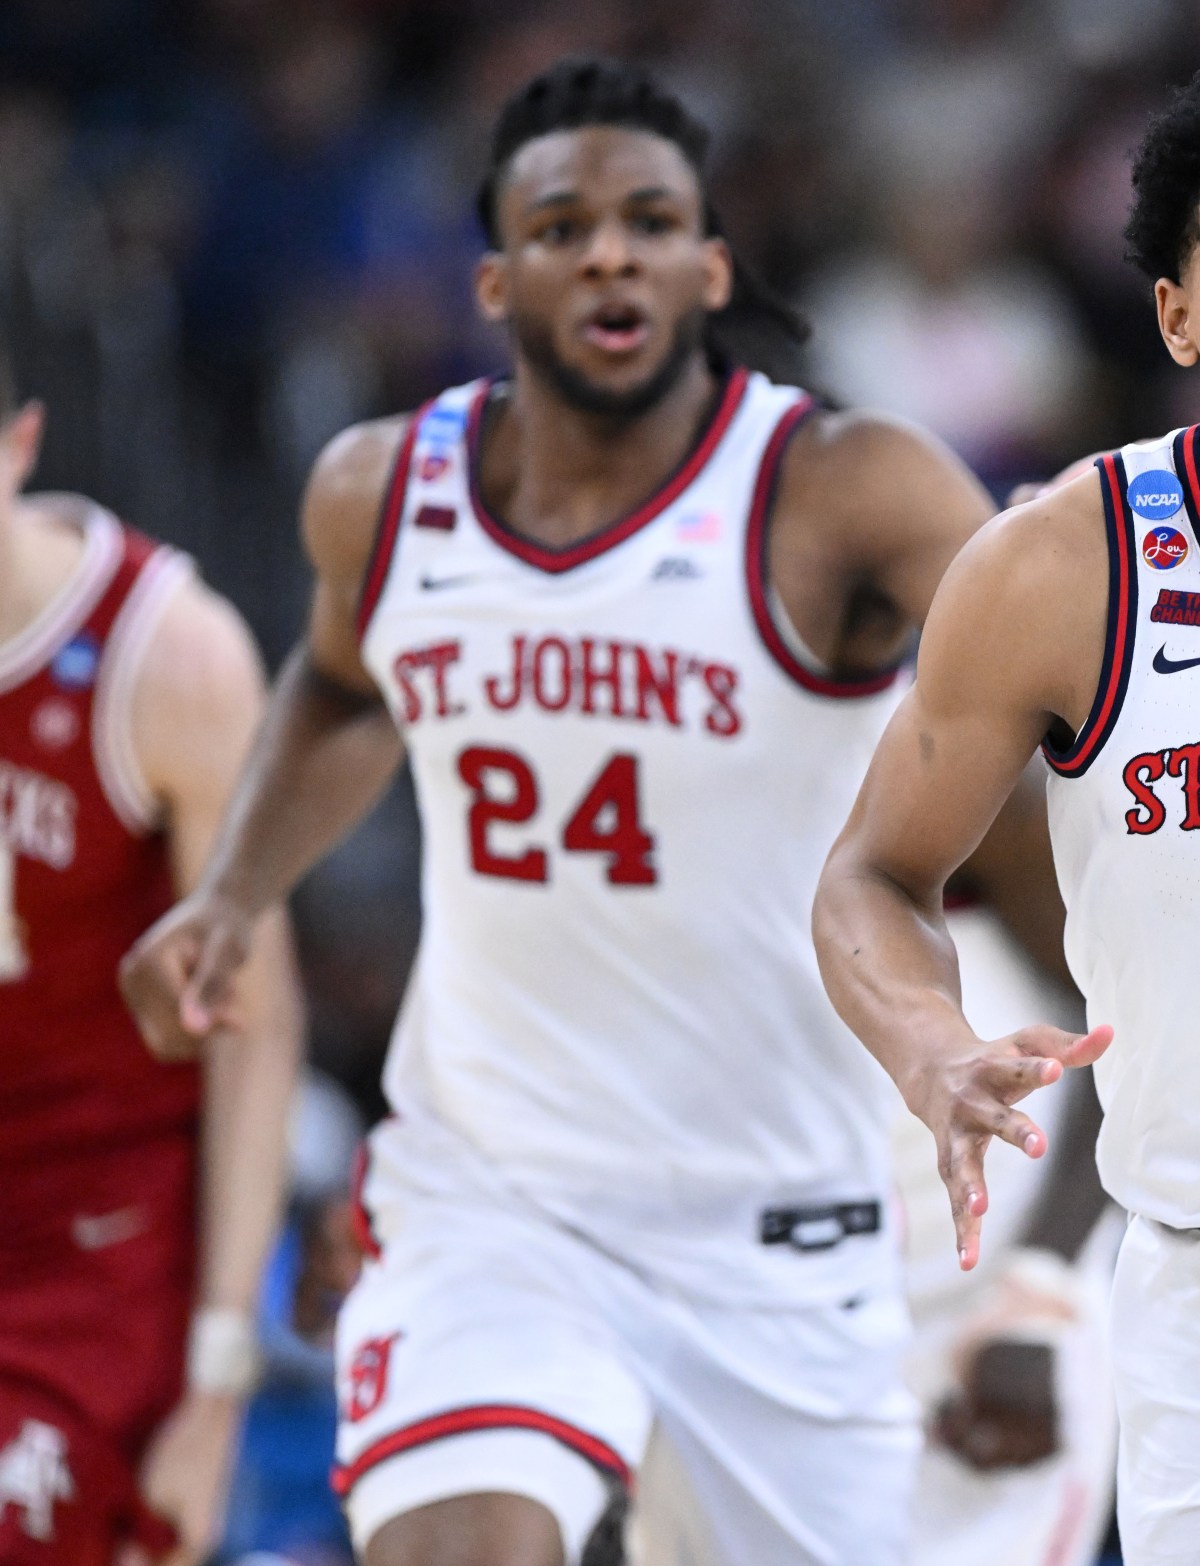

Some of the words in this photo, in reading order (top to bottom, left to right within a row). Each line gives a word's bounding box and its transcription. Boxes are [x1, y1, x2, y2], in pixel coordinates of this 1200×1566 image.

[1136, 494, 1180, 507] NCAA
[1145, 532, 1185, 559] Lou
[1157, 589, 1180, 606] BE
[393, 636, 464, 724] ST.
[484, 634, 743, 738] JOHN'S
[456, 746, 658, 887] 24
